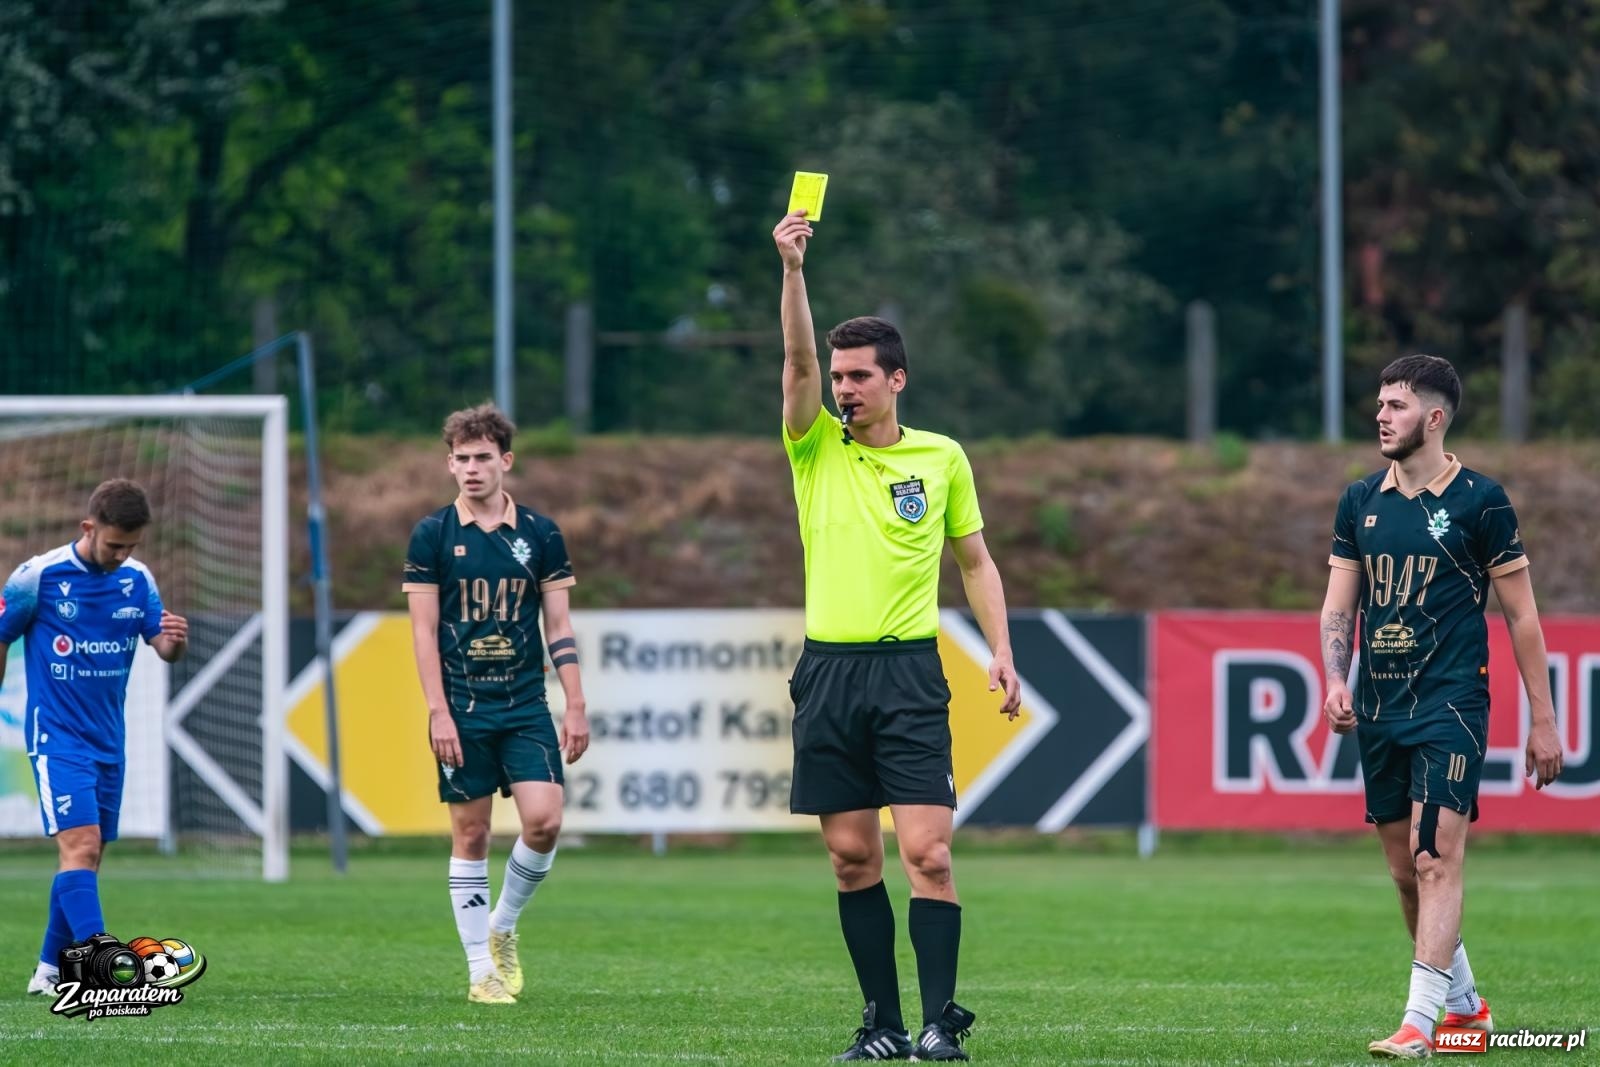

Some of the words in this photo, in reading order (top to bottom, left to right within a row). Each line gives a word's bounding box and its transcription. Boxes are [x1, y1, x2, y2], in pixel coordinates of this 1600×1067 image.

[1364, 553, 1438, 607] 1947
[458, 577, 527, 623] 1947
[75, 640, 120, 654] Marco
[1371, 670, 1420, 680] HERKULES
[588, 702, 704, 739] sztof
[1447, 752, 1467, 782] 10
[618, 771, 700, 810] 680
